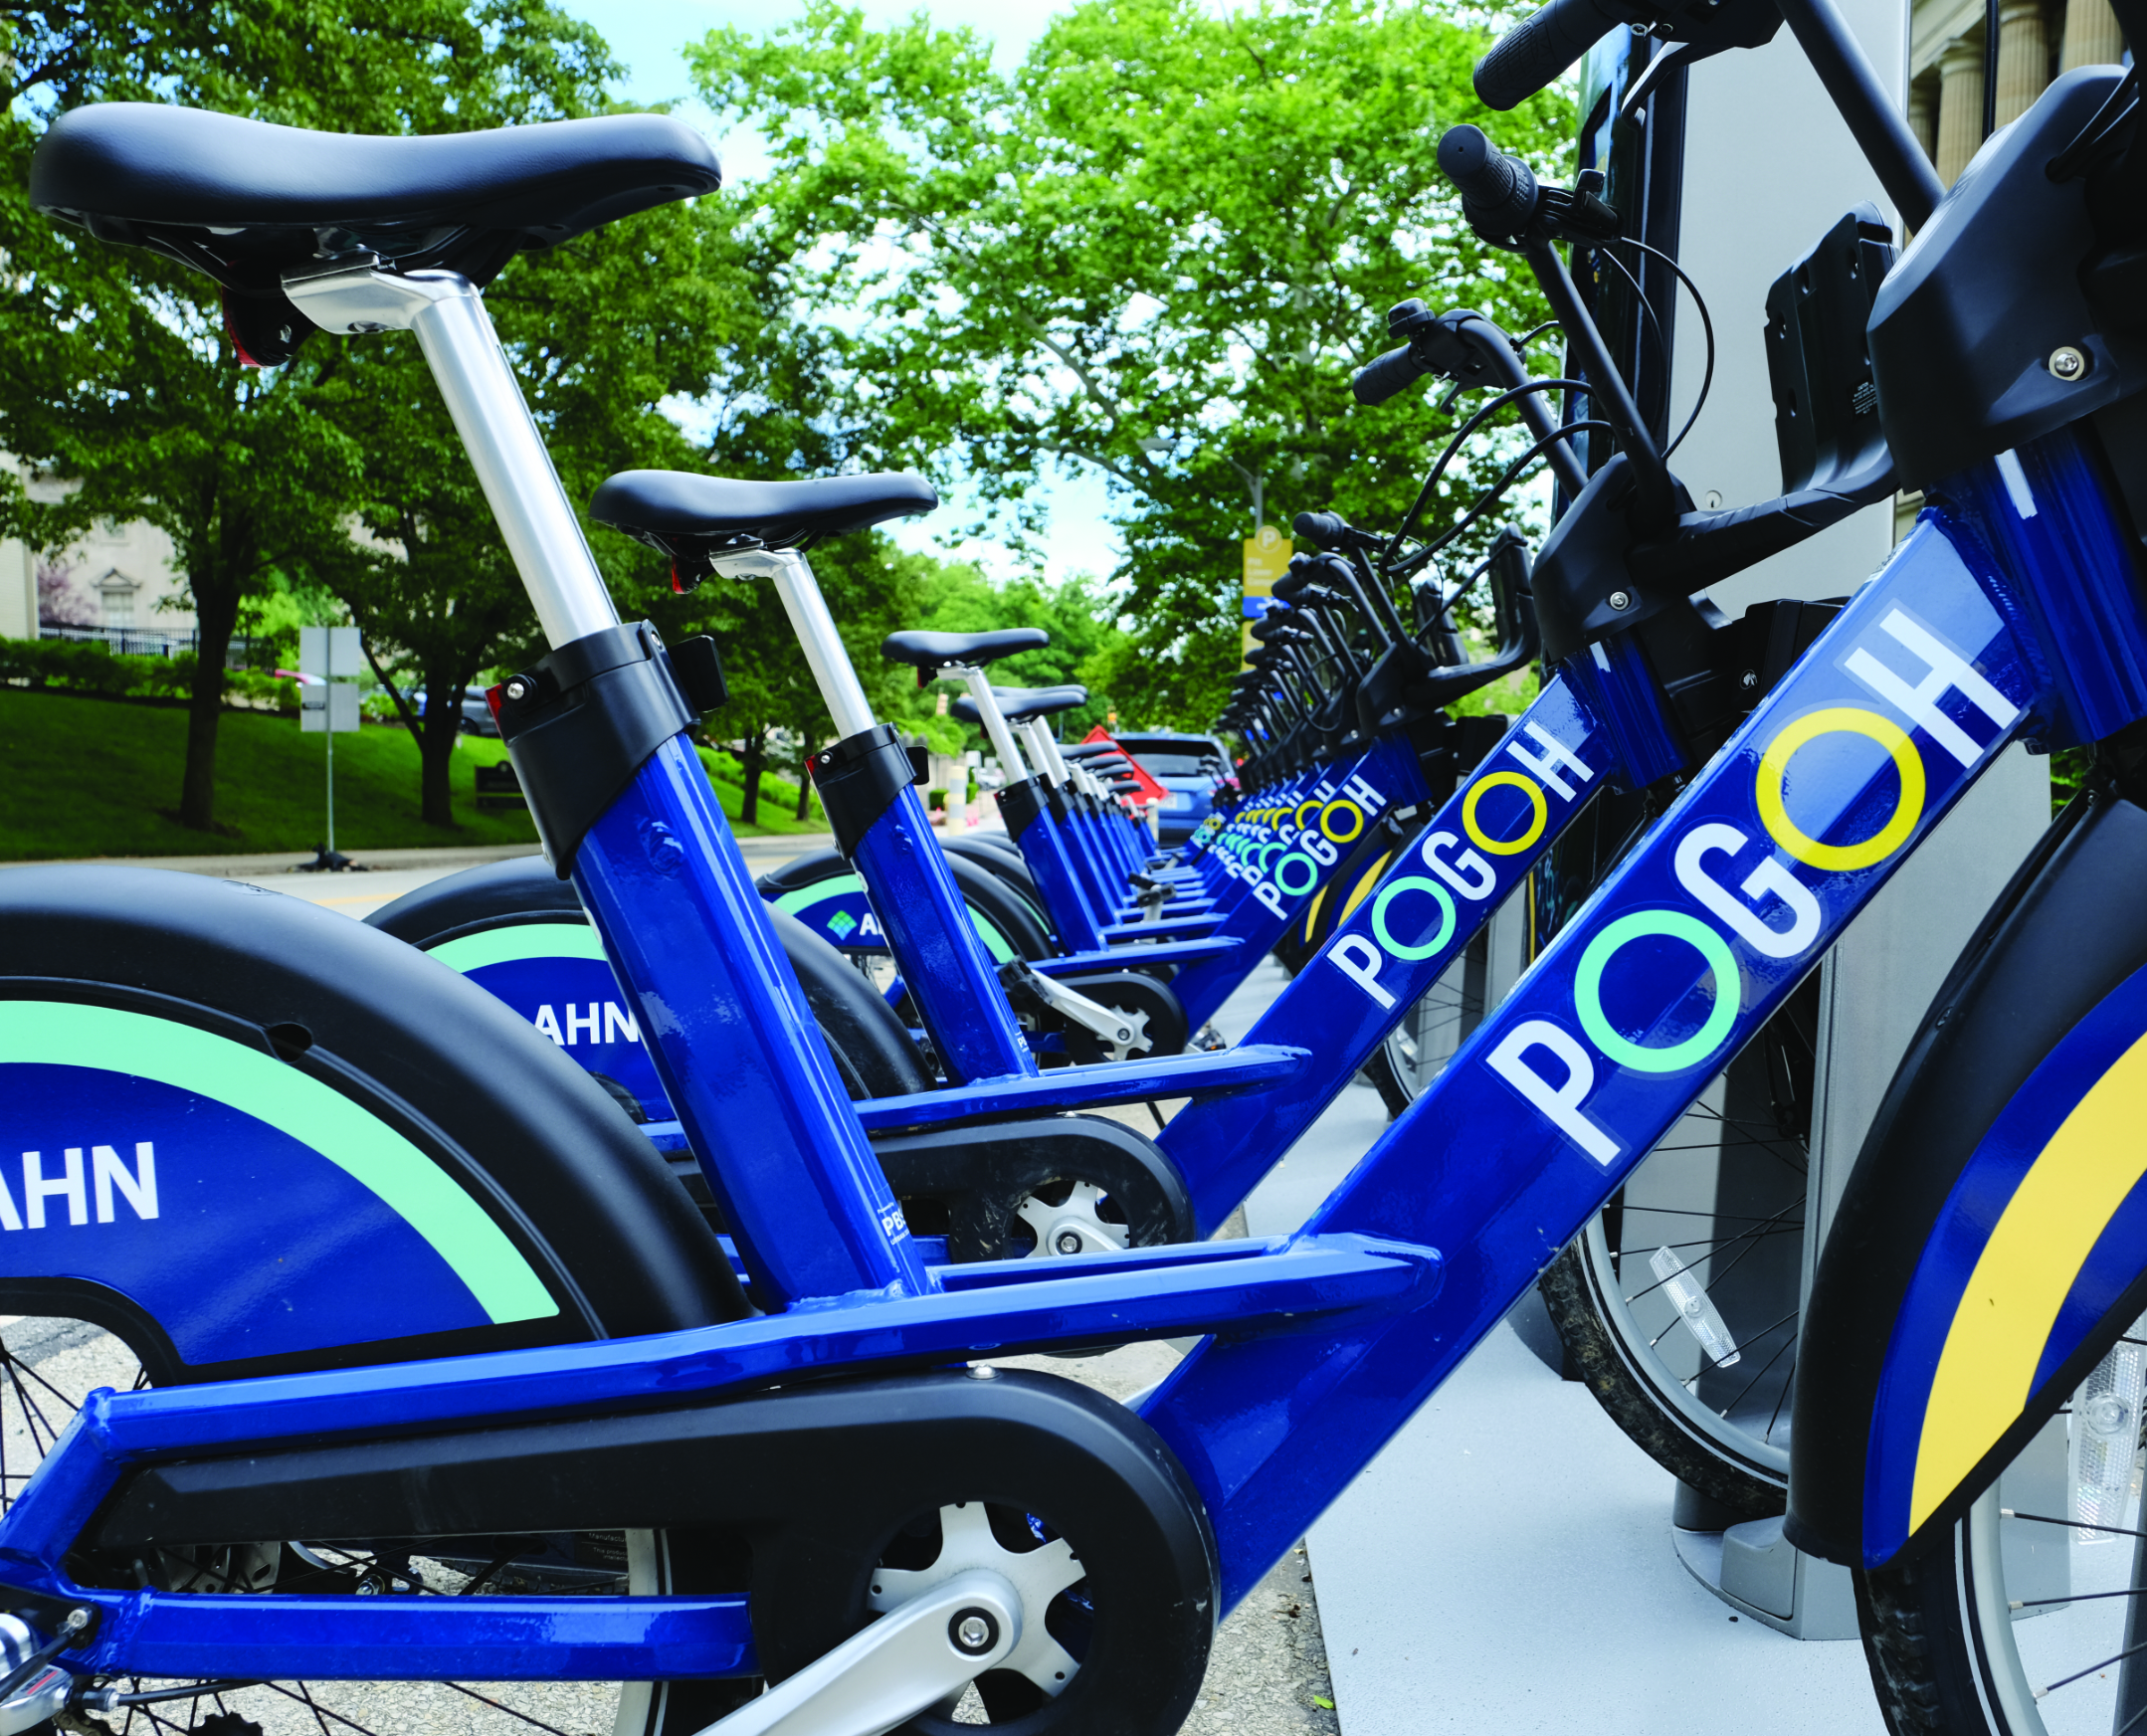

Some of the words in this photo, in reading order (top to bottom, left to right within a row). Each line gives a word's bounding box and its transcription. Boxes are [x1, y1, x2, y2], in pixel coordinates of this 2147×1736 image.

[1253, 774, 1387, 921] POGOH
[1326, 720, 1594, 1010] POGOH
[1485, 608, 2022, 1166] POGOH
[534, 1001, 639, 1046] AHN
